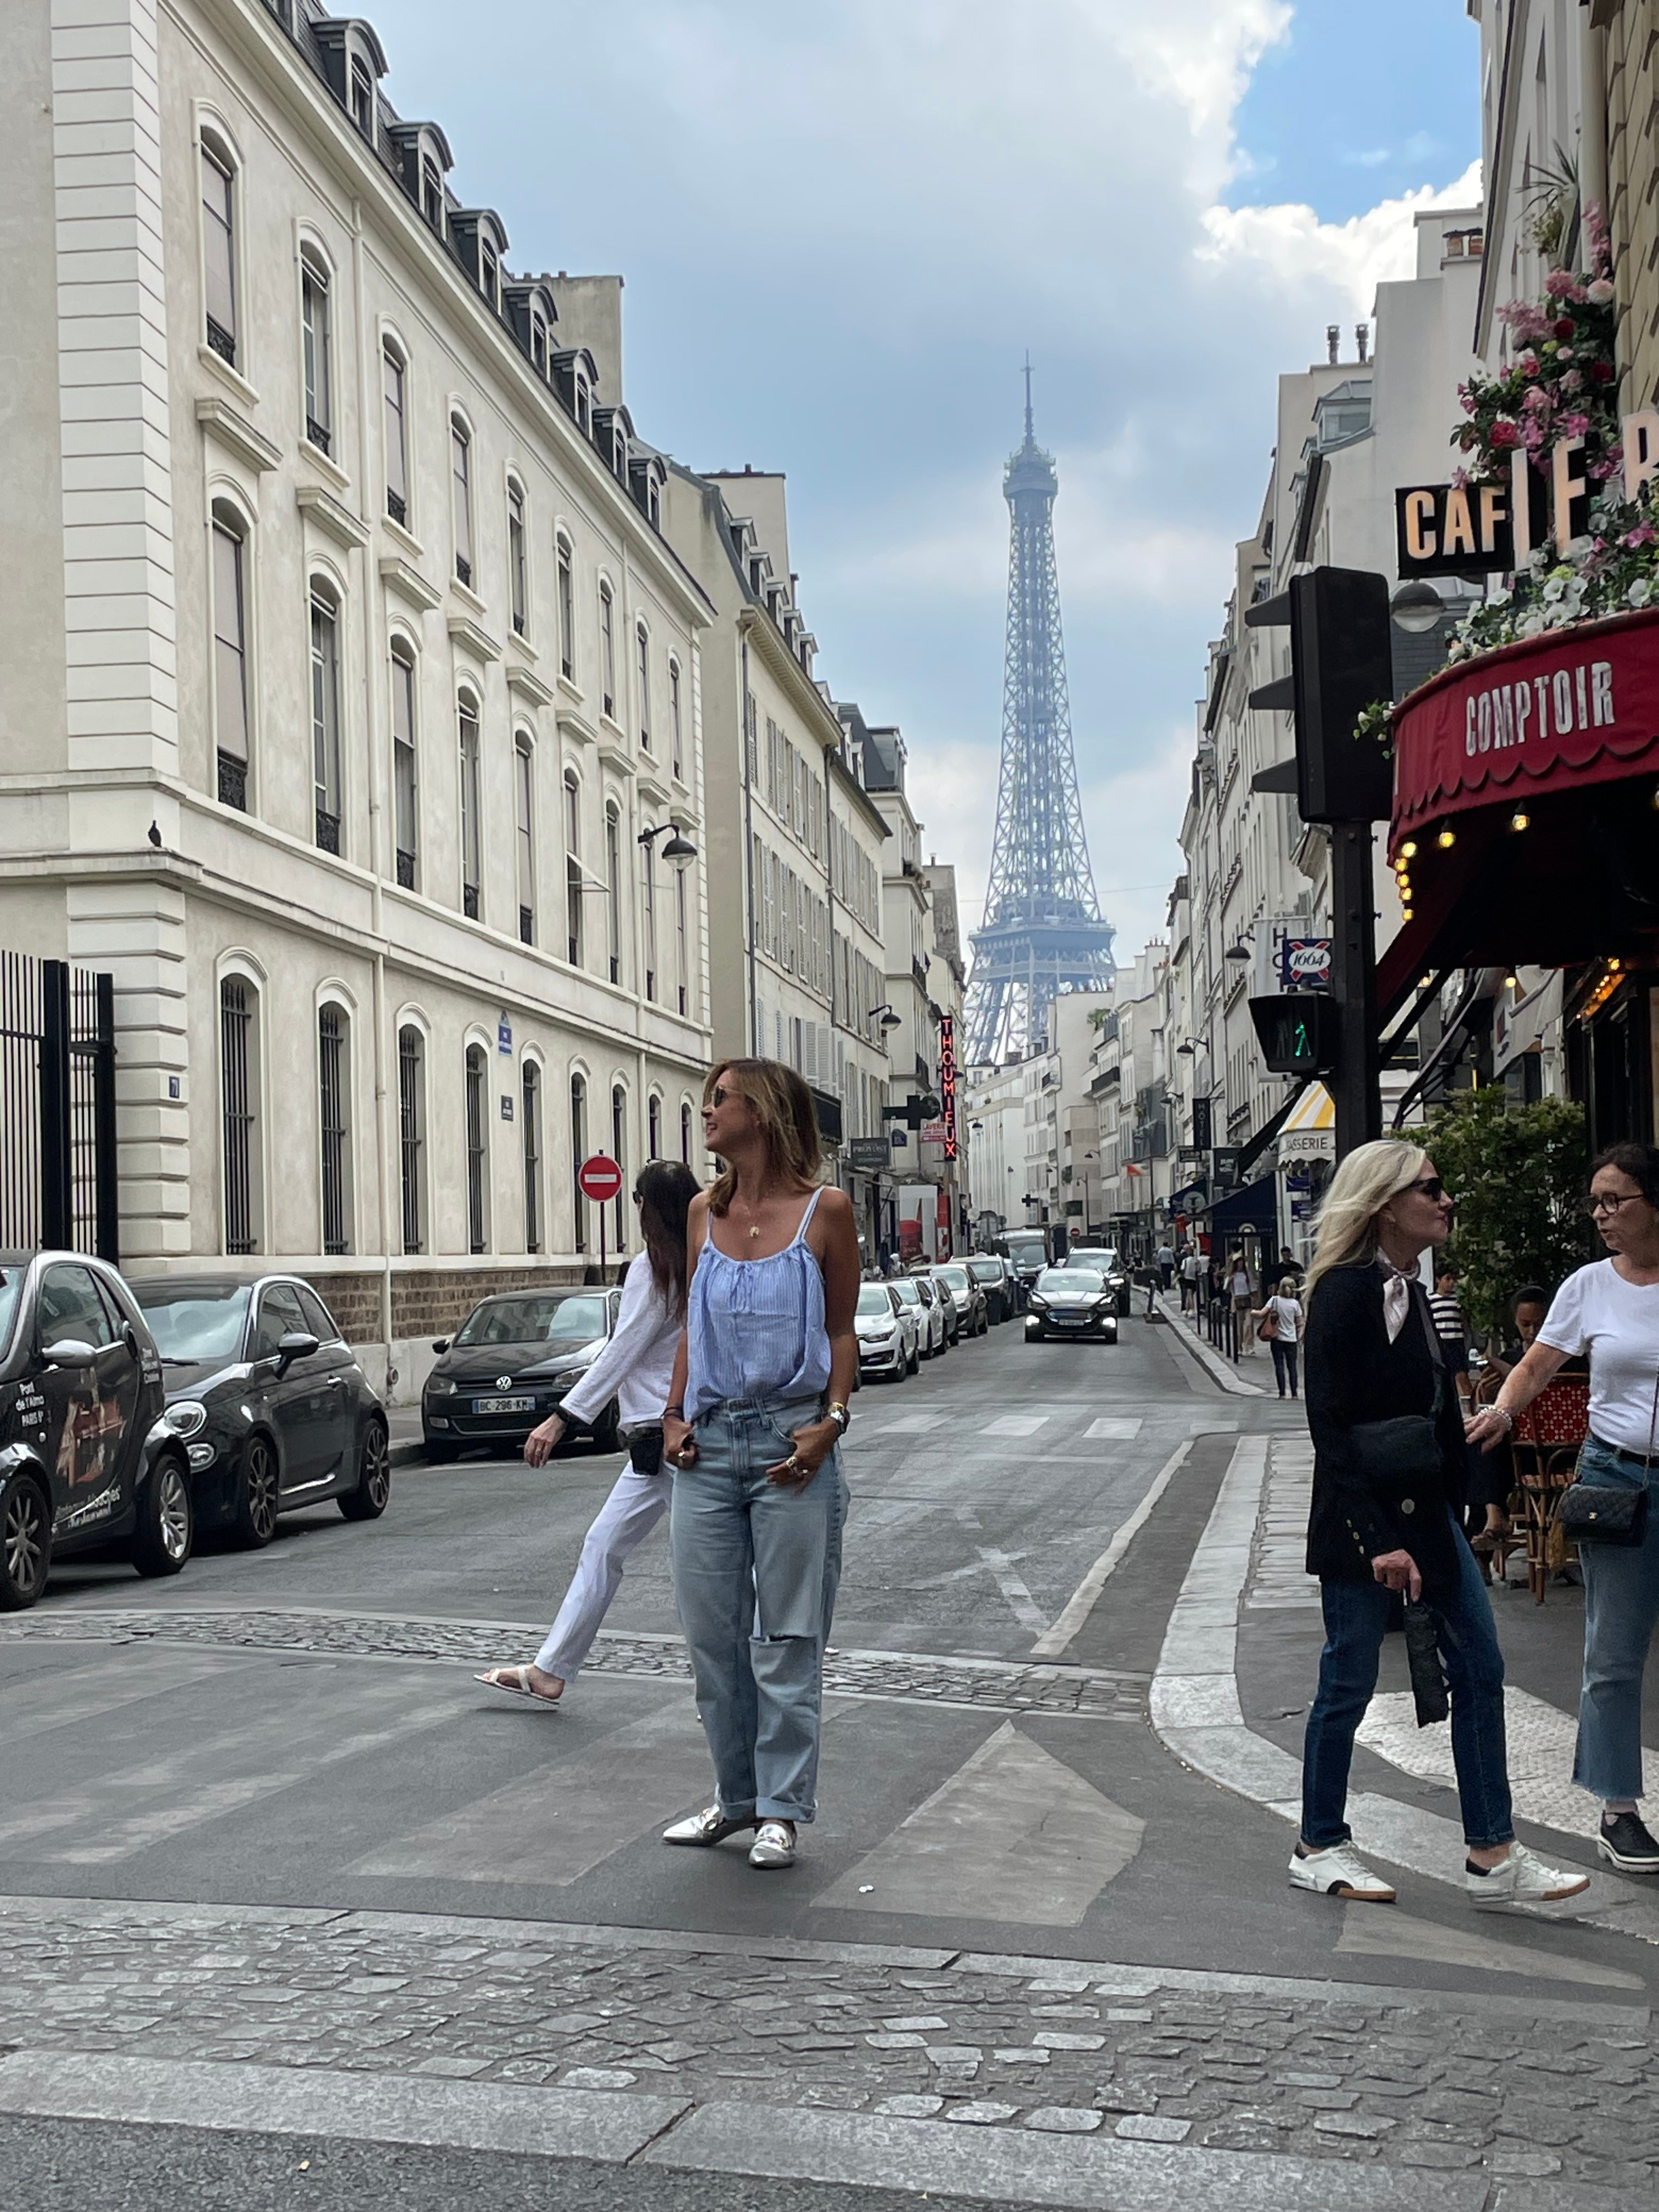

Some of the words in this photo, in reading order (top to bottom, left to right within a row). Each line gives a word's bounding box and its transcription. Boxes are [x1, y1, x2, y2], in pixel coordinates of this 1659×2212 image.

[1405, 486, 1508, 560] CAF
[1465, 661, 1616, 757] COMPTOIR
[1293, 951, 1325, 967] 1664
[942, 1019, 956, 1157] THOUMIEUX
